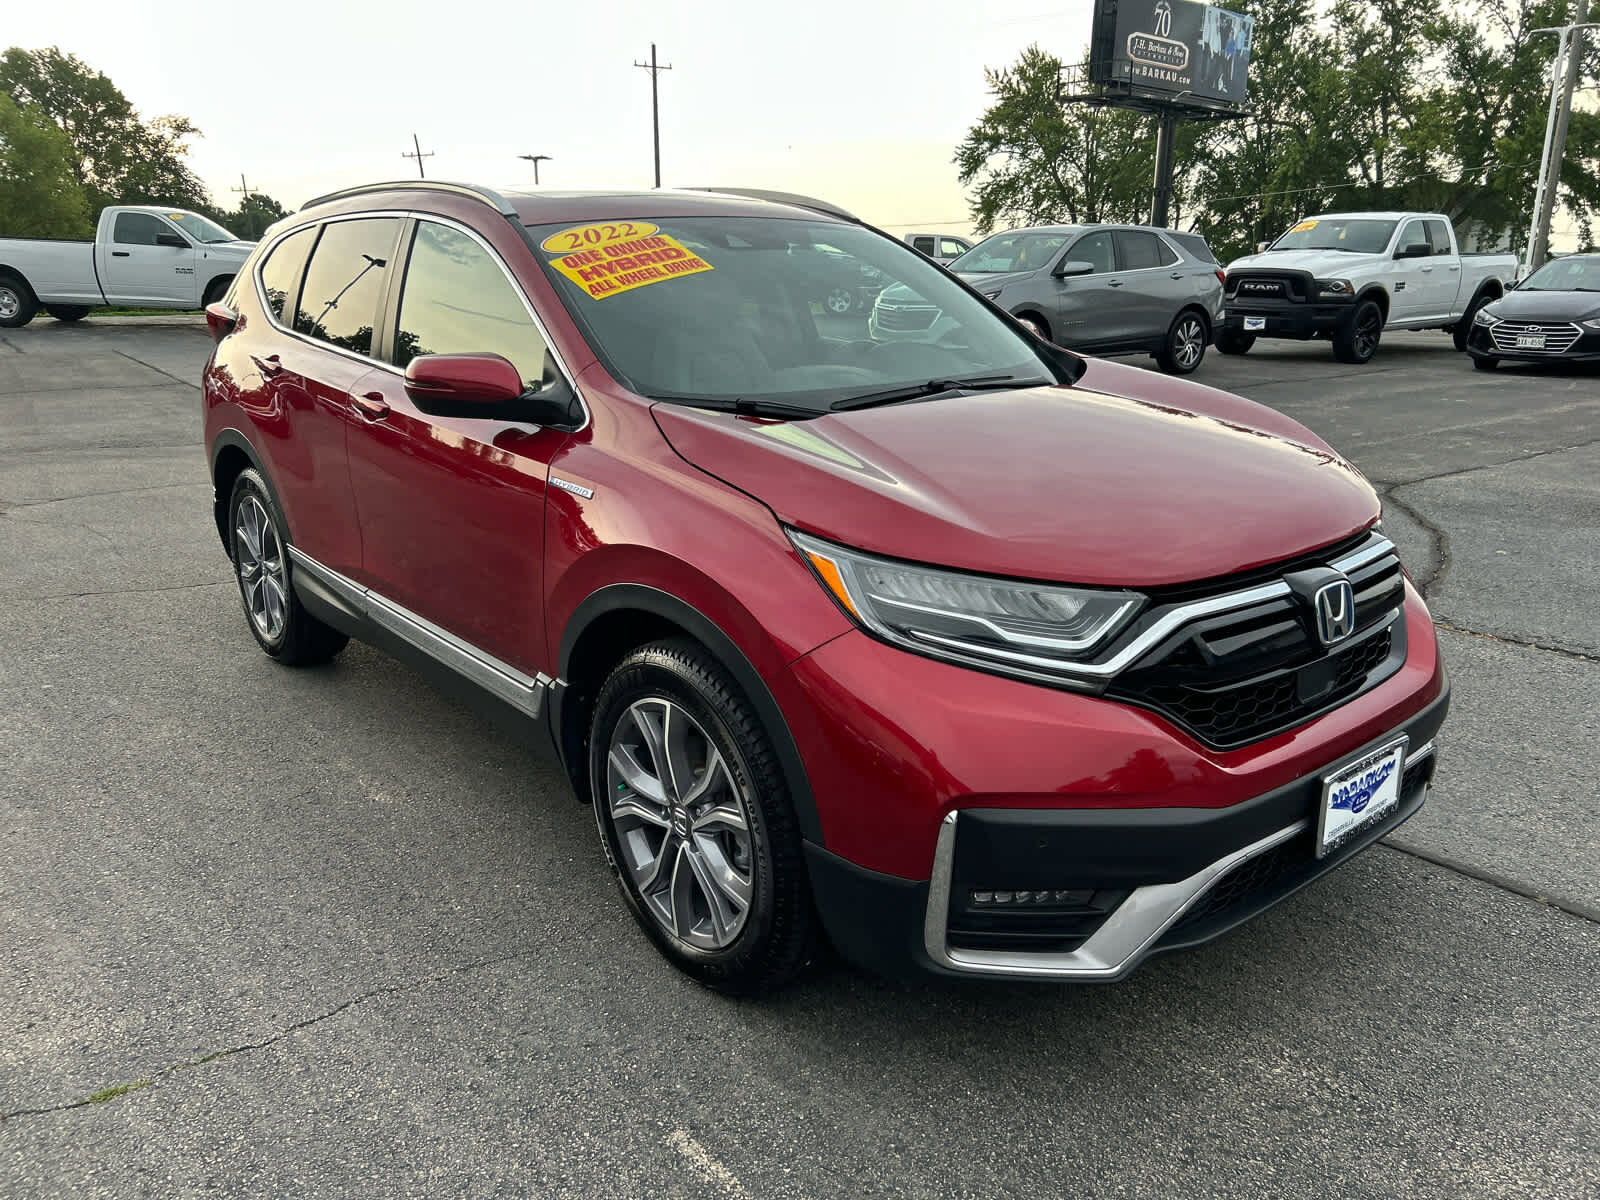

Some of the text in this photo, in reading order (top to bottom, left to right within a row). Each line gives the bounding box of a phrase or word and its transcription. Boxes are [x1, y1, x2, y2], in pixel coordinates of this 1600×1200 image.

[1154, 8, 1172, 37] 70
[564, 223, 638, 249] 2022
[562, 236, 670, 269] ONE OWNER
[576, 247, 687, 282] HYBRID
[588, 256, 707, 296] ALL WHEEL DRIVE
[553, 479, 589, 496] HYBRID
